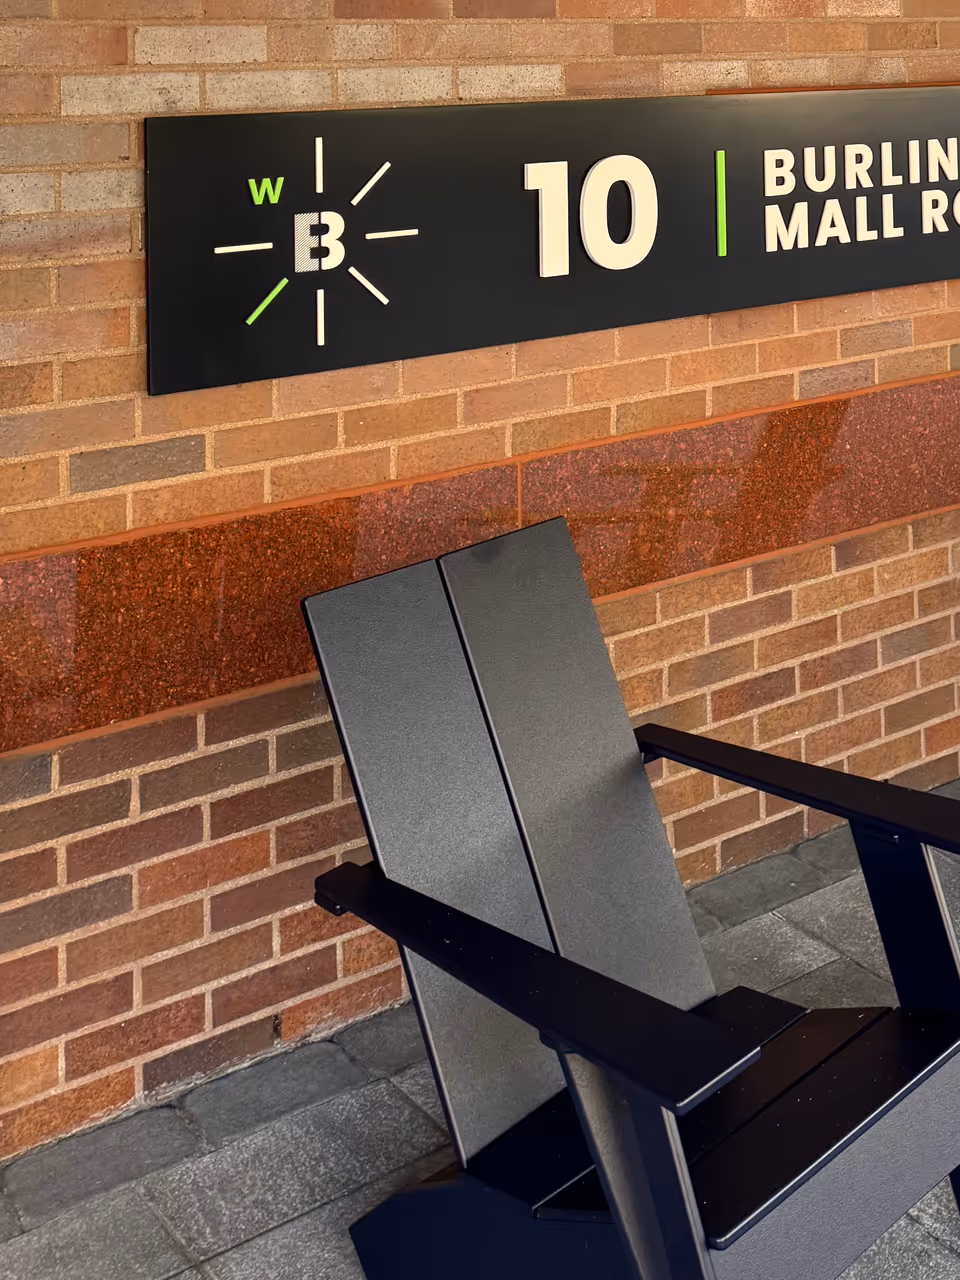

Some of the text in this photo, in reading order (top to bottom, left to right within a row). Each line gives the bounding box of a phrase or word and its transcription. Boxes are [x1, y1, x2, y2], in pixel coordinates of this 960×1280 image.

[248, 176, 285, 205] W
[523, 154, 659, 278] 10
[293, 211, 346, 273] B
[764, 193, 904, 253] MALL
